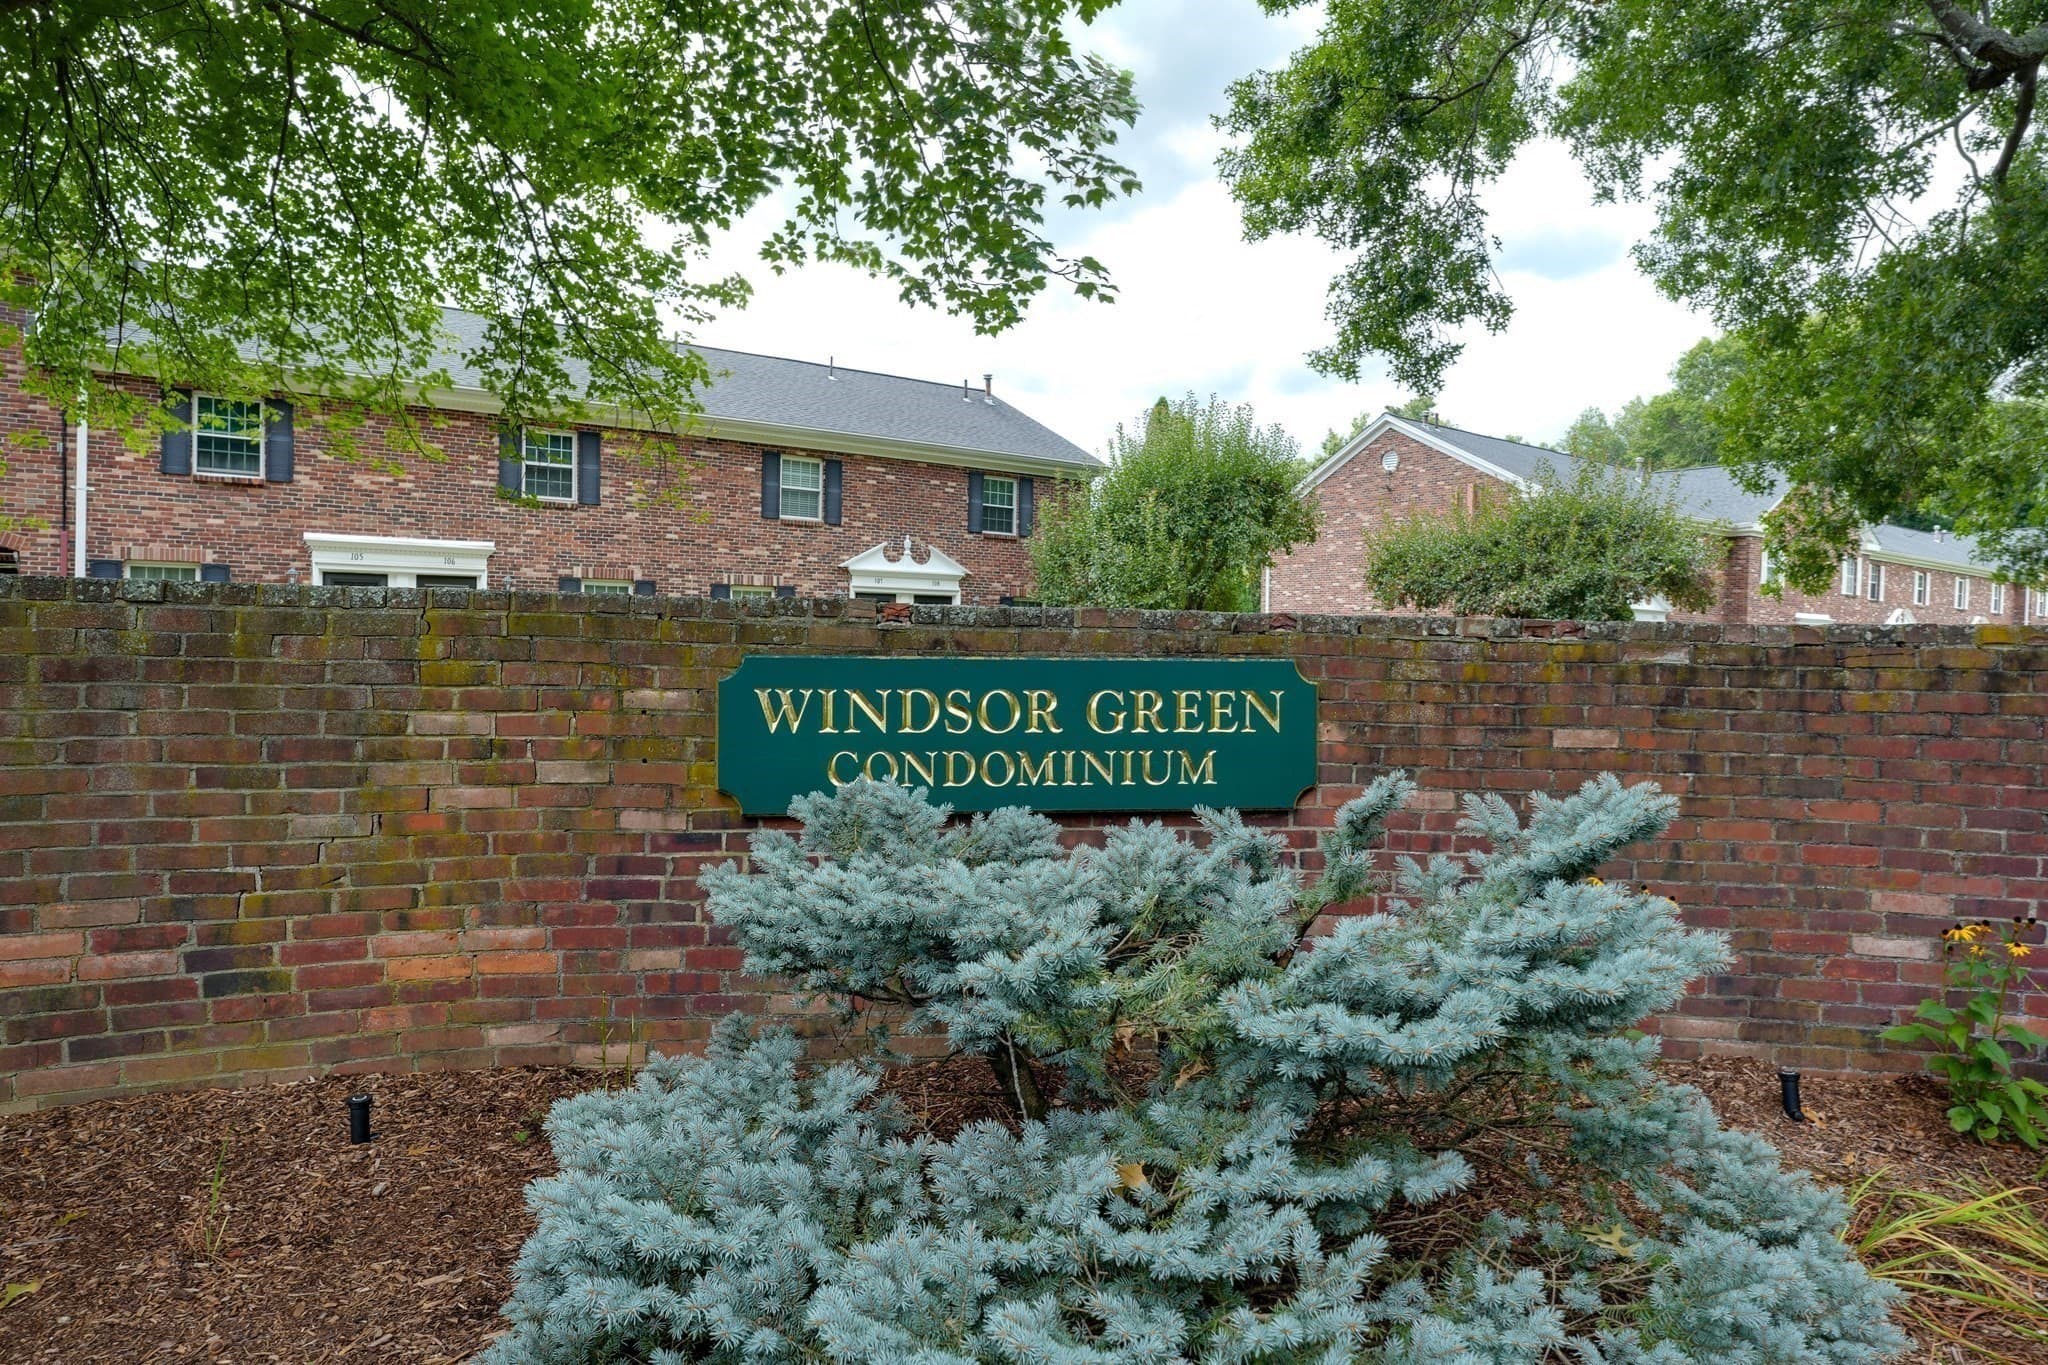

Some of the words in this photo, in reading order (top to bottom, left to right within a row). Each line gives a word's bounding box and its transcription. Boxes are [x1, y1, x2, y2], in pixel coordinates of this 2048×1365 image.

[351, 553, 364, 561] 105
[444, 557, 456, 565] 106
[753, 688, 1063, 734] WINDSOR
[1087, 690, 1285, 735] GREEN
[828, 750, 1218, 787] CONDOMINIUM
